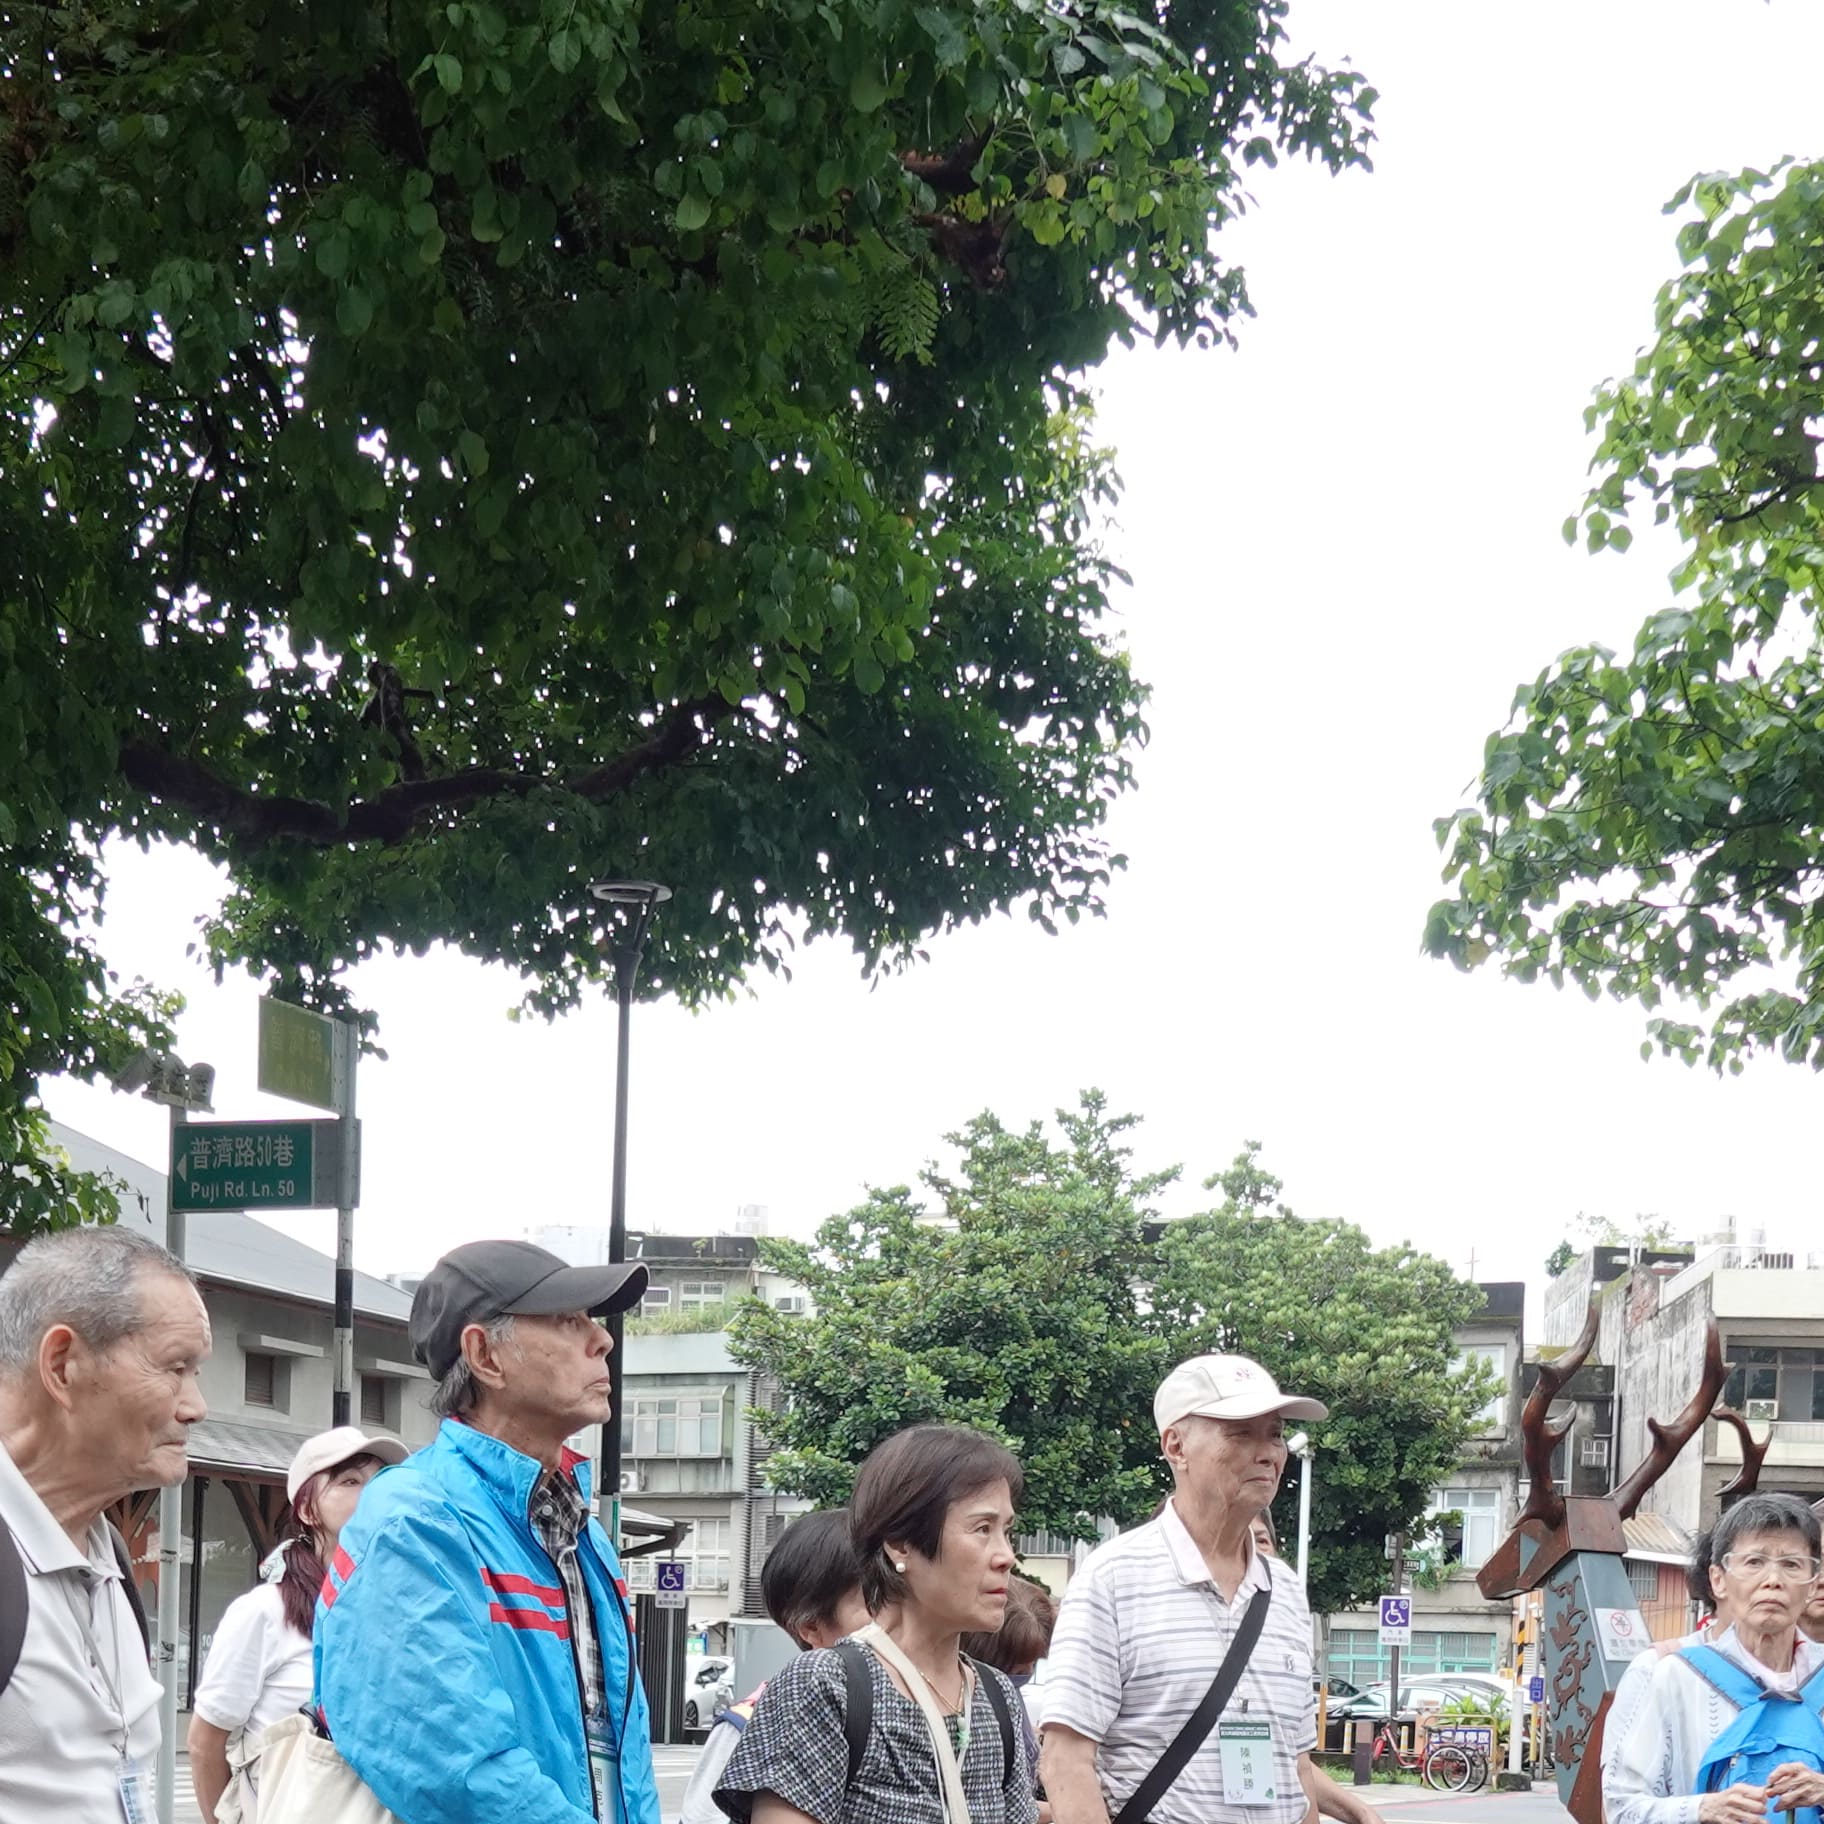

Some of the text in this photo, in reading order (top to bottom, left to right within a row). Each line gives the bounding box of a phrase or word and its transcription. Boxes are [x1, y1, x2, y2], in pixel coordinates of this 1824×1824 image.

[190, 1135, 294, 1170] 普濟路50巷
[191, 1180, 295, 1204] Puji Rd. Ln. 50
